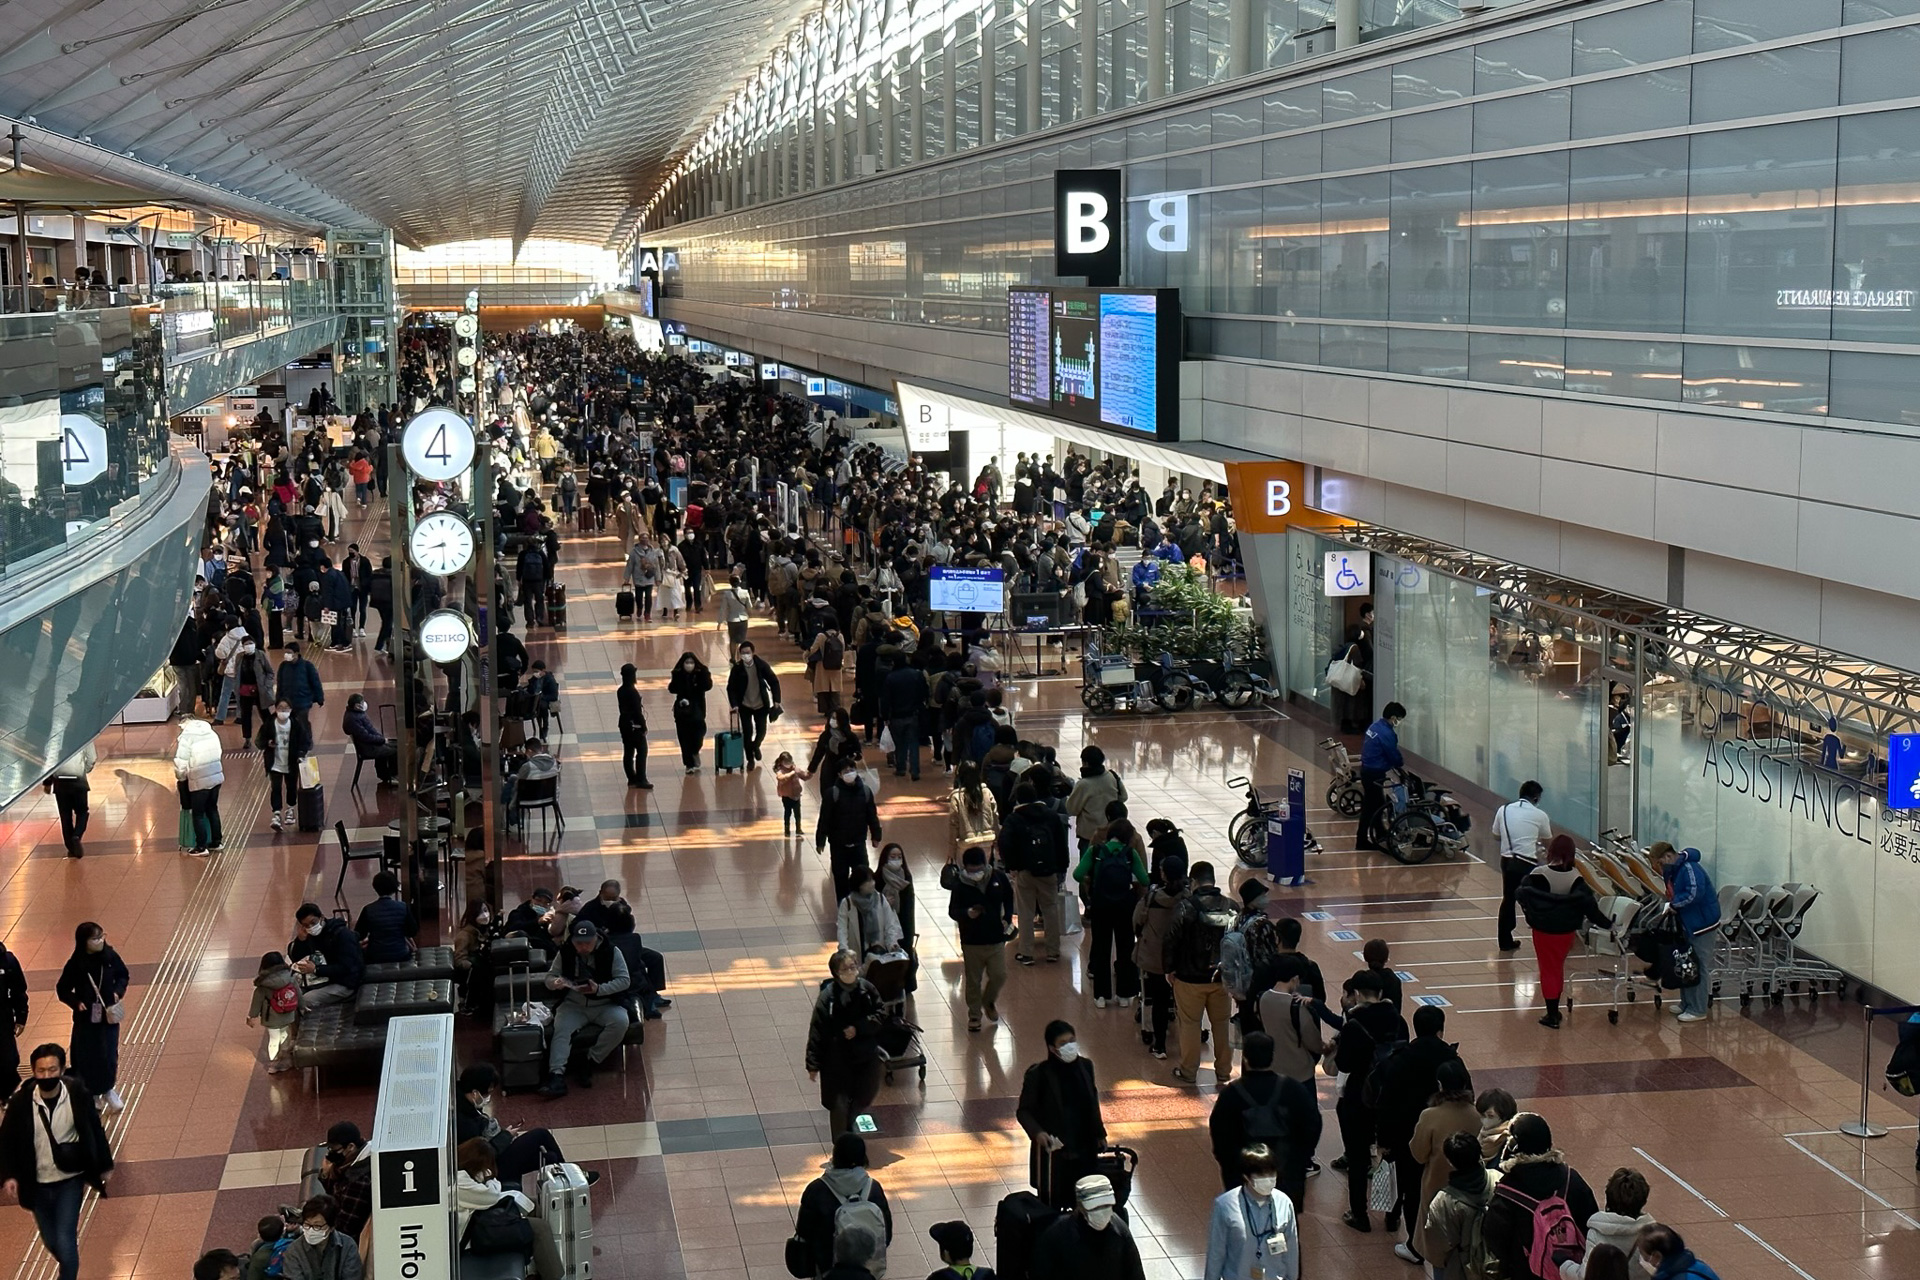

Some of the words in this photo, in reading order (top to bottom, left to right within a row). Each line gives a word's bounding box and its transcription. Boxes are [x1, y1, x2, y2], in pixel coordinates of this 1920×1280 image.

[1067, 191, 1110, 254] B
[641, 252, 658, 271] A
[461, 319, 471, 333] 3
[665, 324, 675, 334] A
[920, 404, 932, 423] B
[424, 423, 452, 466] 4
[1267, 480, 1291, 516] B
[1330, 553, 1337, 562] 8
[425, 633, 466, 643] SEIKO
[1703, 684, 1812, 766] SPECIAL
[1902, 738, 1911, 752] 9
[1702, 735, 1873, 845] ASSISTANCE
[401, 1160, 418, 1193] i
[400, 1224, 426, 1279] Info
